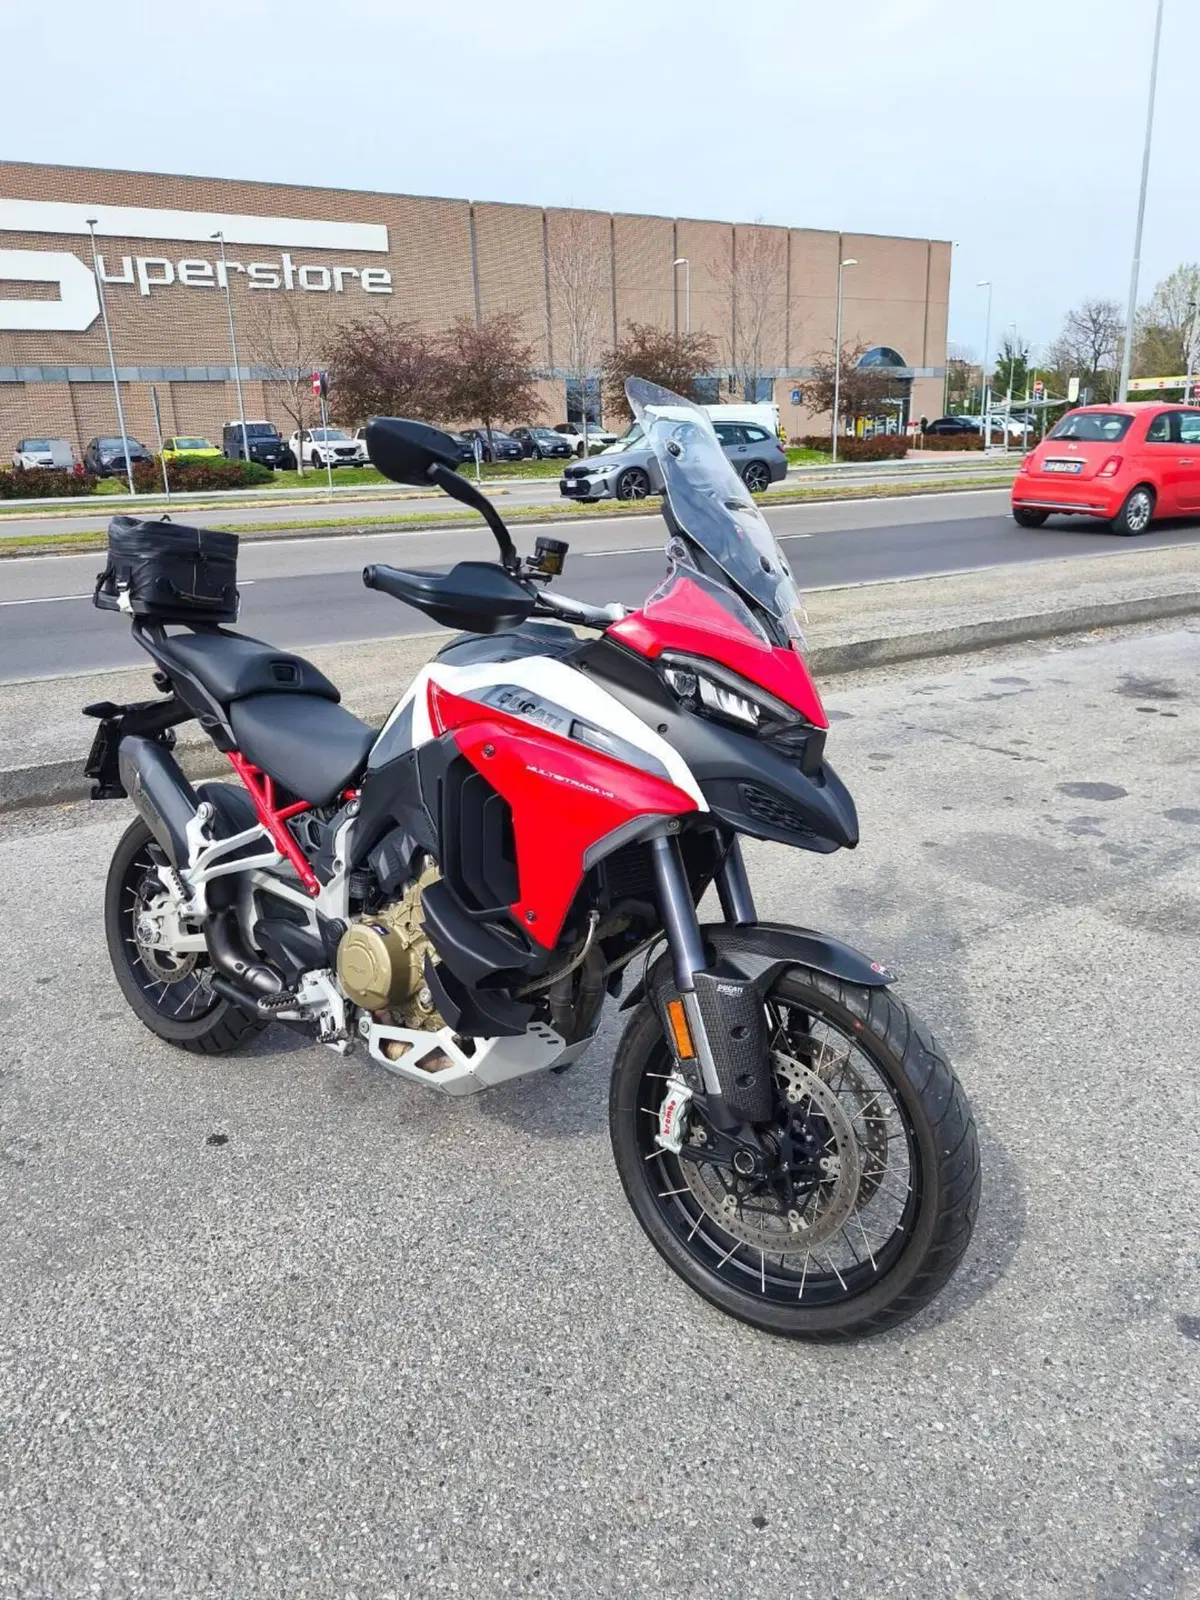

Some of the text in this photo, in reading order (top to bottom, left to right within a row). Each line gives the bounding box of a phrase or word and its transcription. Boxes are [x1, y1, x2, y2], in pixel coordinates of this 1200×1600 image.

[498, 692, 564, 729] DUCATI
[525, 765, 600, 794] MULTISTRADA
[663, 1100, 676, 1135] brembo
